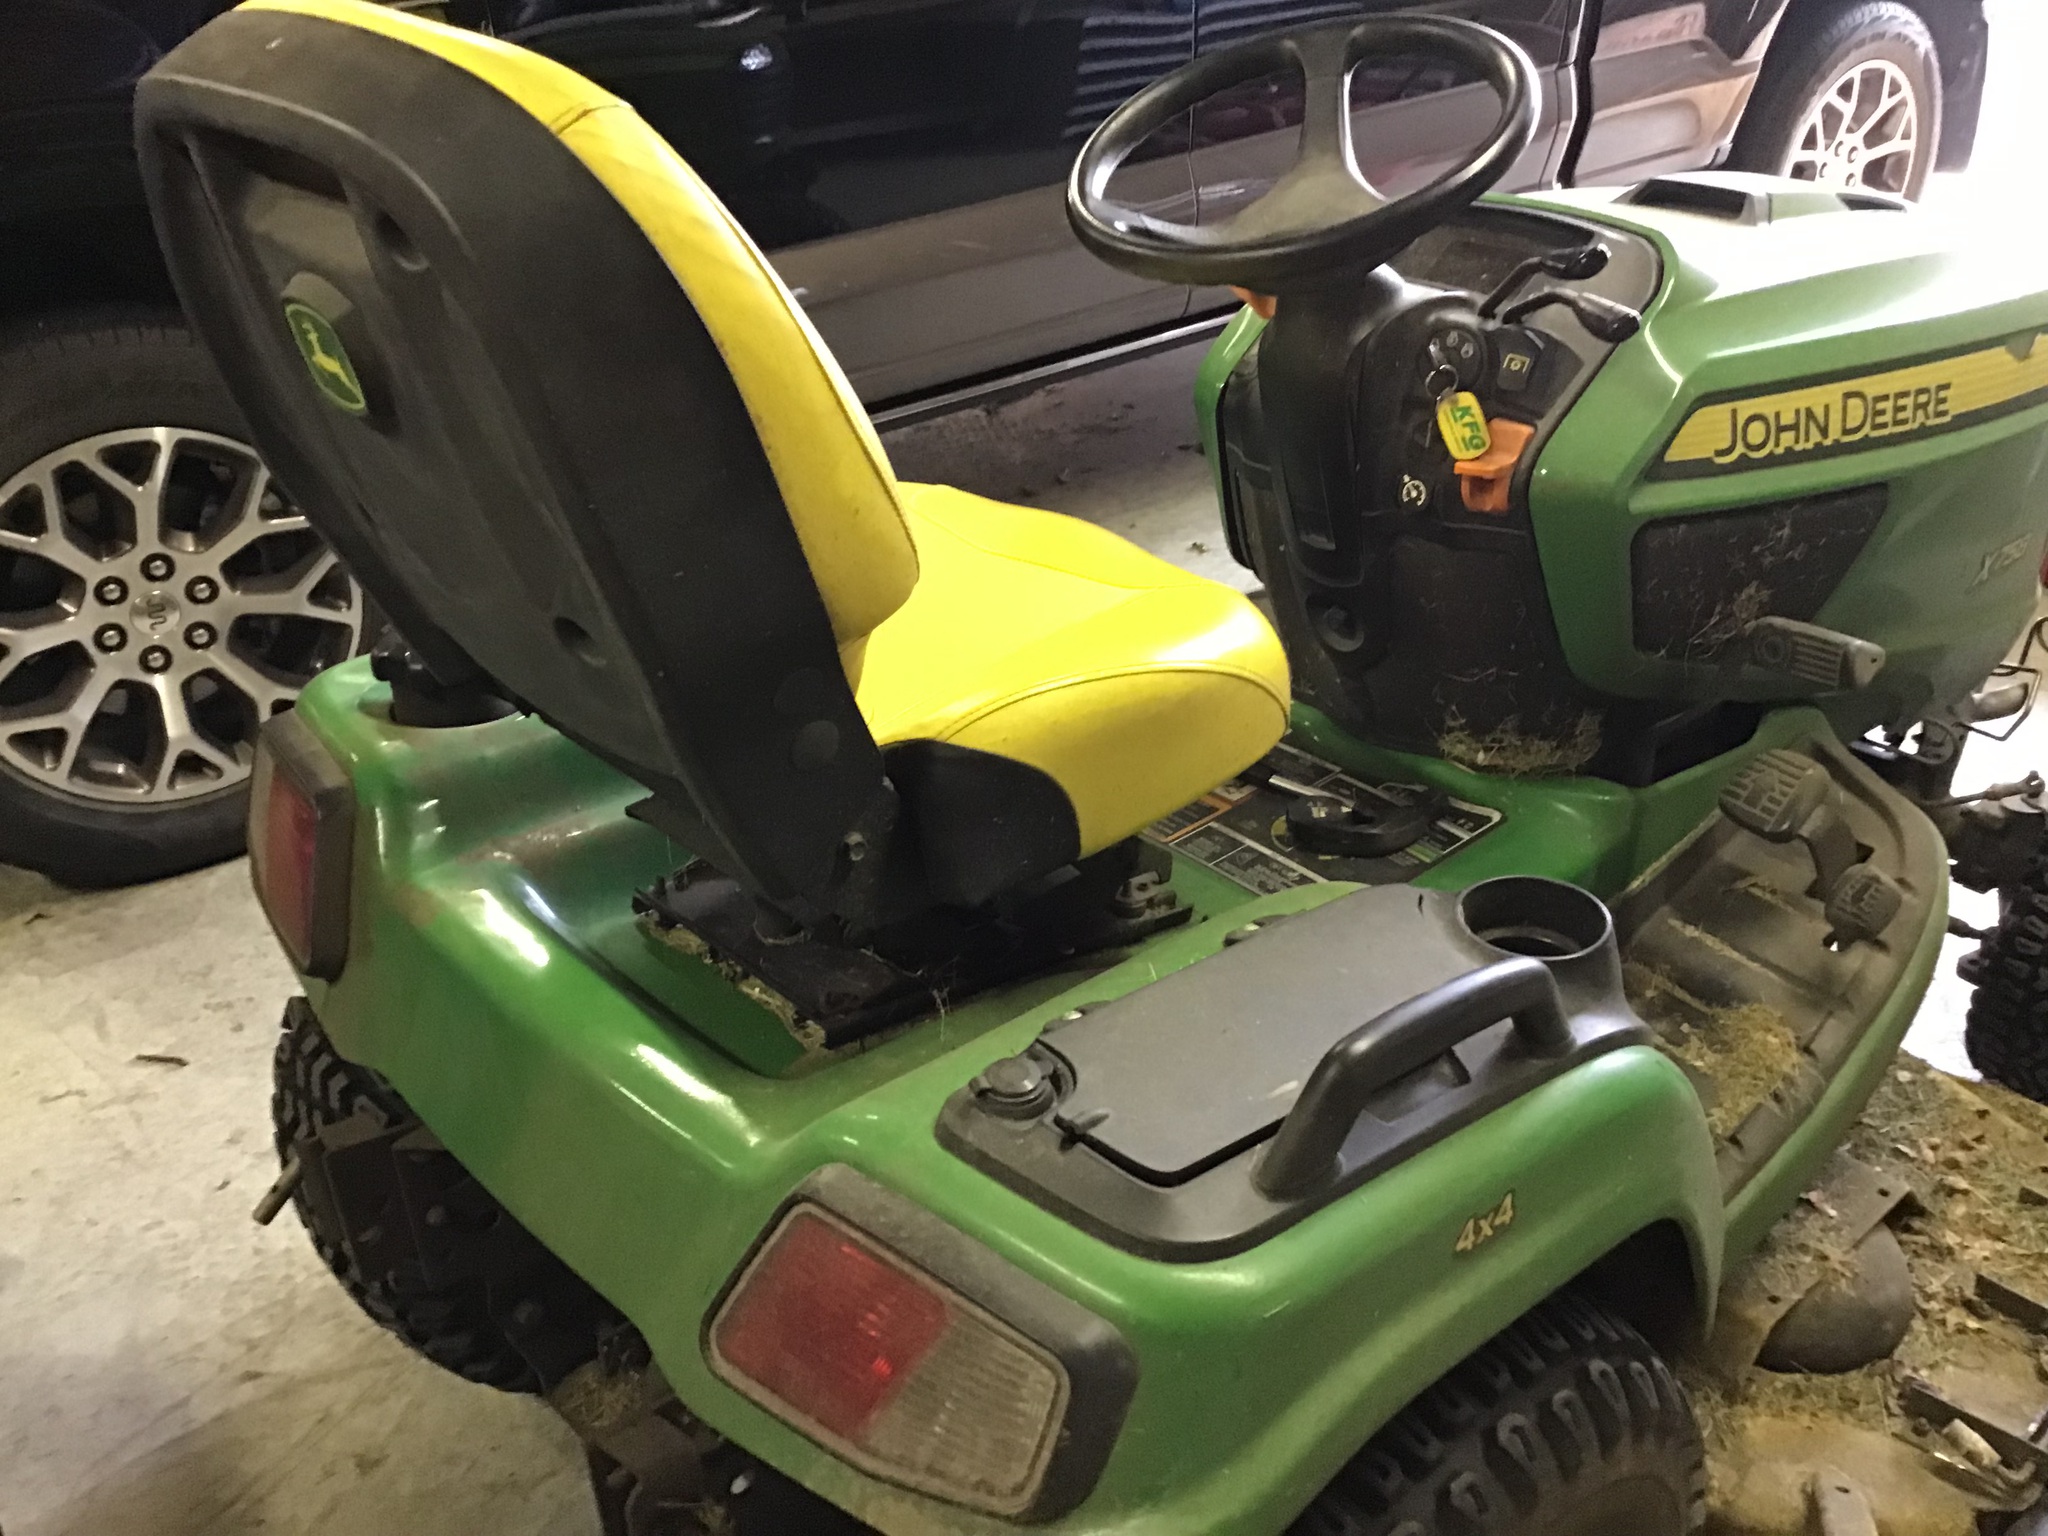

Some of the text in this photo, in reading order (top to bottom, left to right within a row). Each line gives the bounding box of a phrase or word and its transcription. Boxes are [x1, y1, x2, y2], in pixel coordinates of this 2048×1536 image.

[1714, 382, 1952, 457] JOHN DEERE
[1456, 1191, 1514, 1253] 4x4
